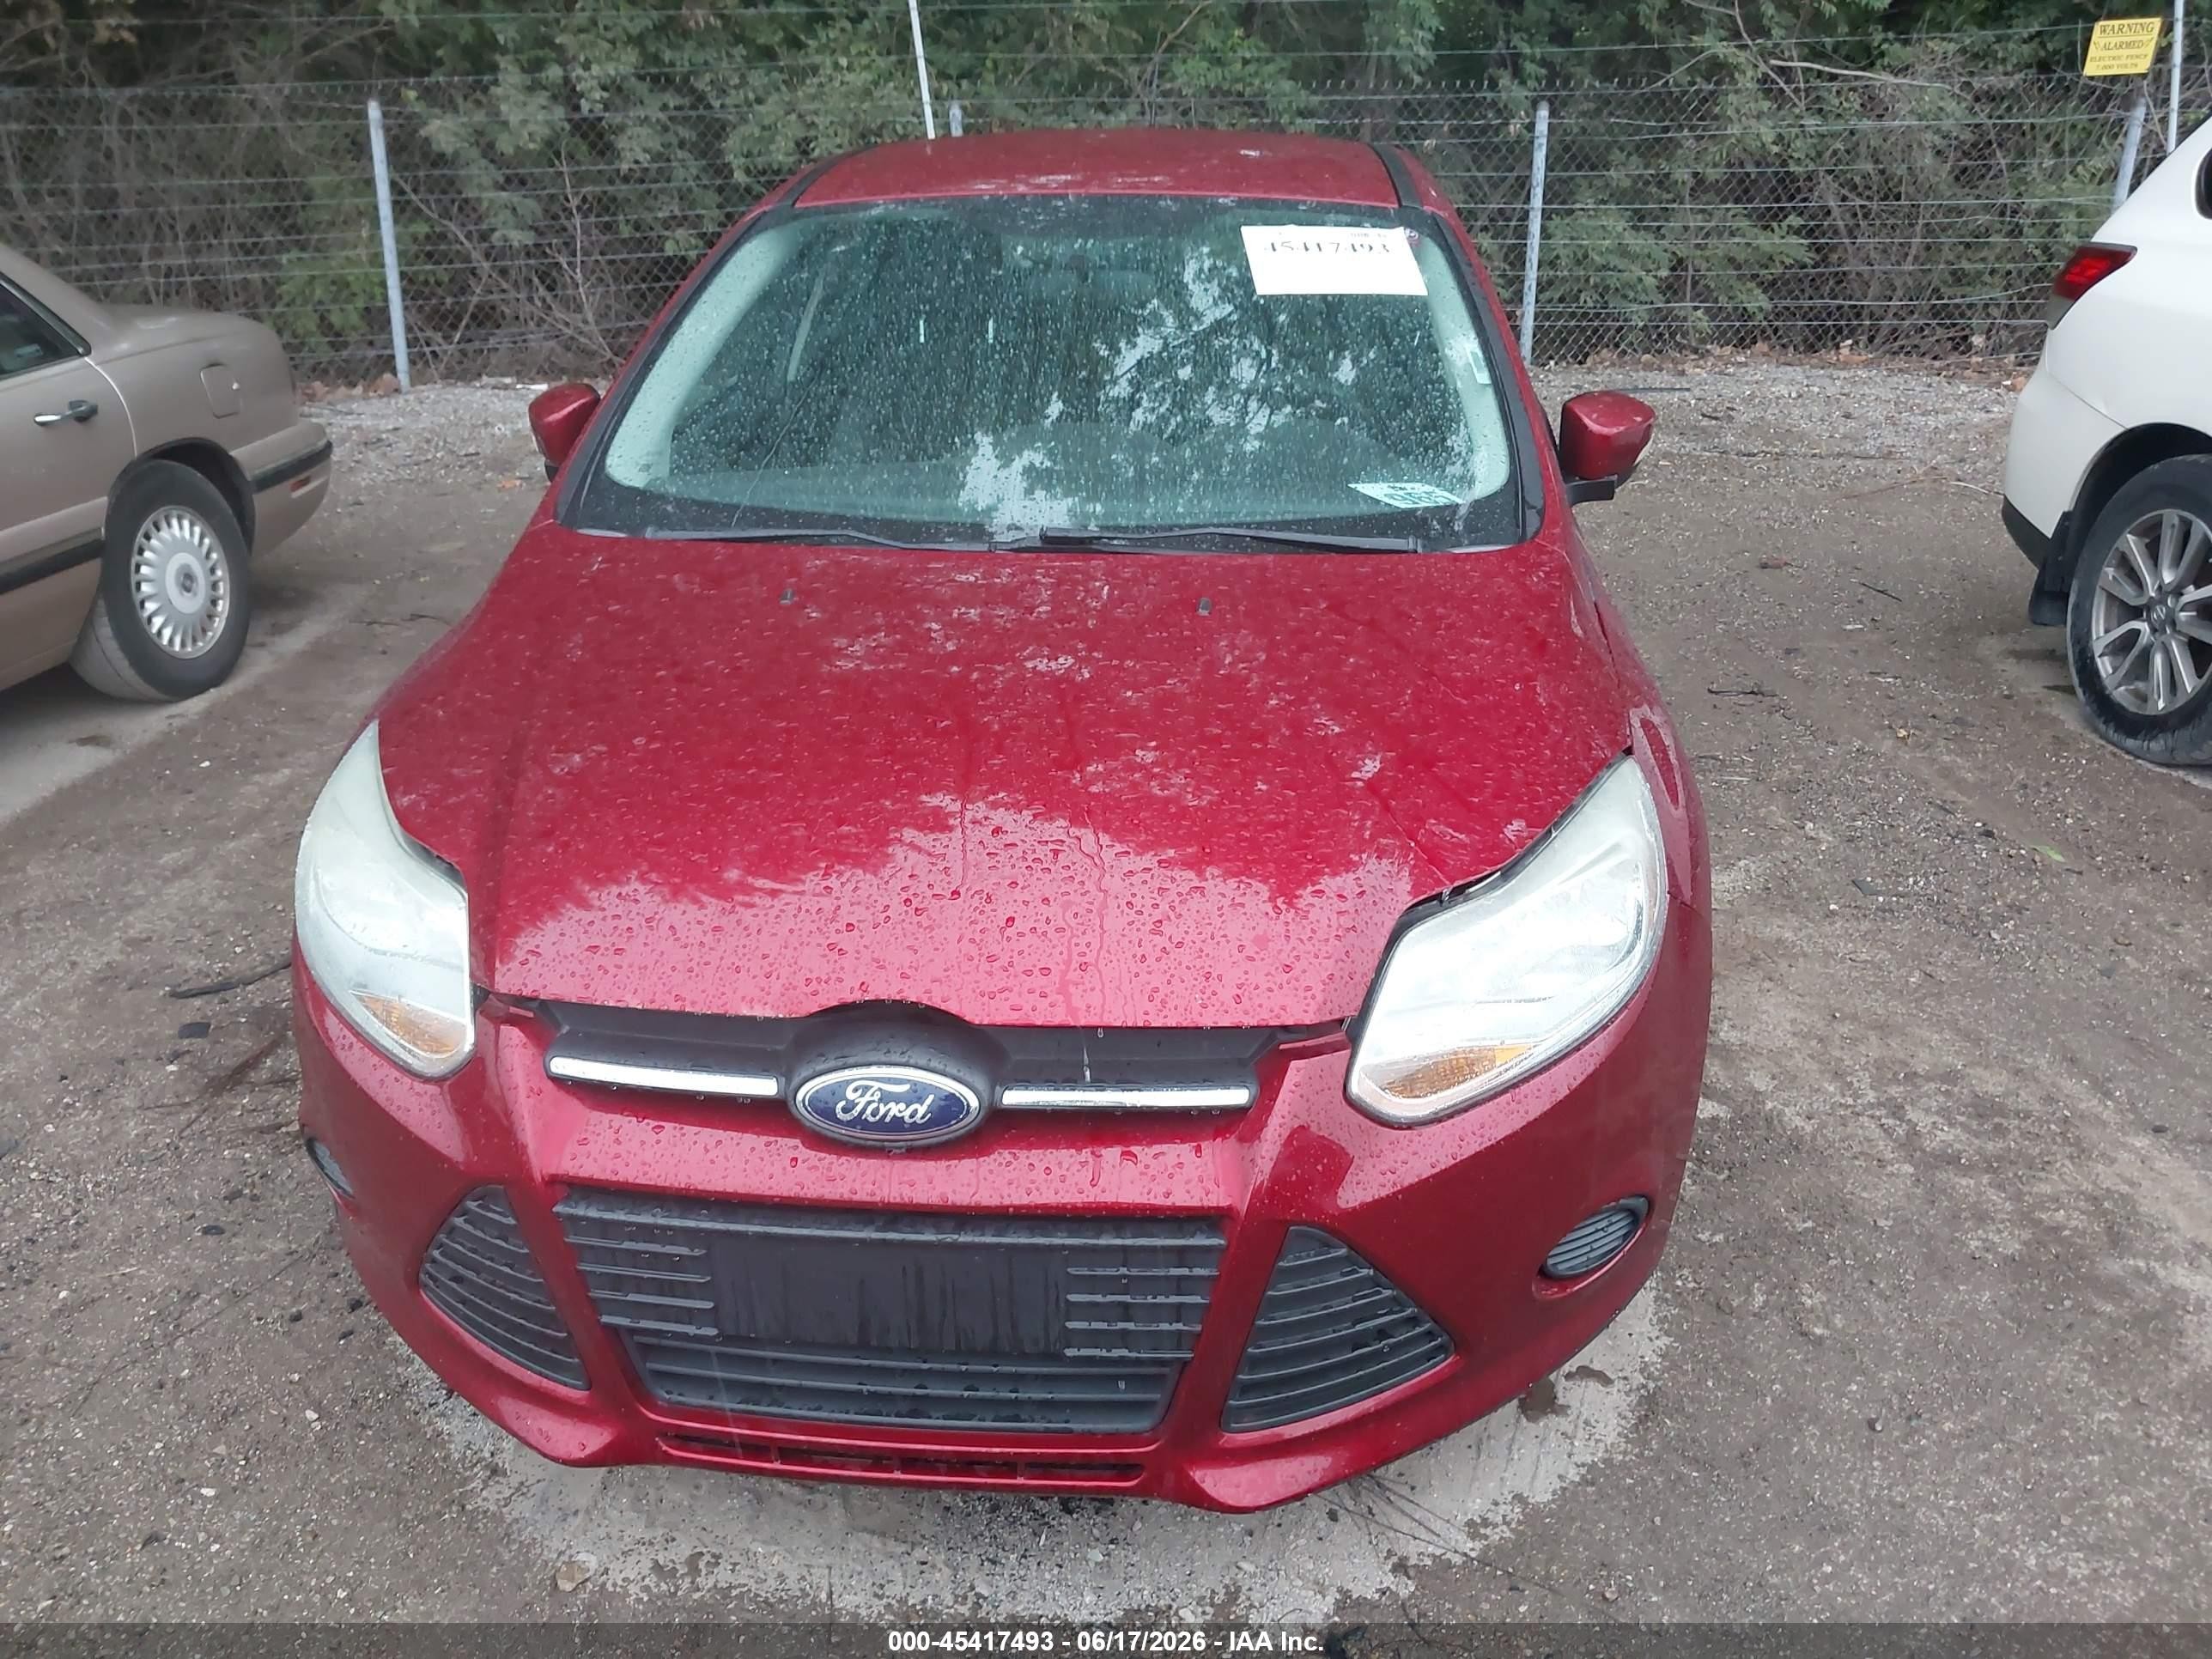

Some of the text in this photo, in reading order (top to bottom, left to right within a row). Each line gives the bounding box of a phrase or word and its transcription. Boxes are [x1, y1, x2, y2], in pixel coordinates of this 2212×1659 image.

[2099, 21, 2154, 35] WARNING
[2101, 40, 2145, 51] ALARMED
[836, 1079, 935, 1124] Ford
